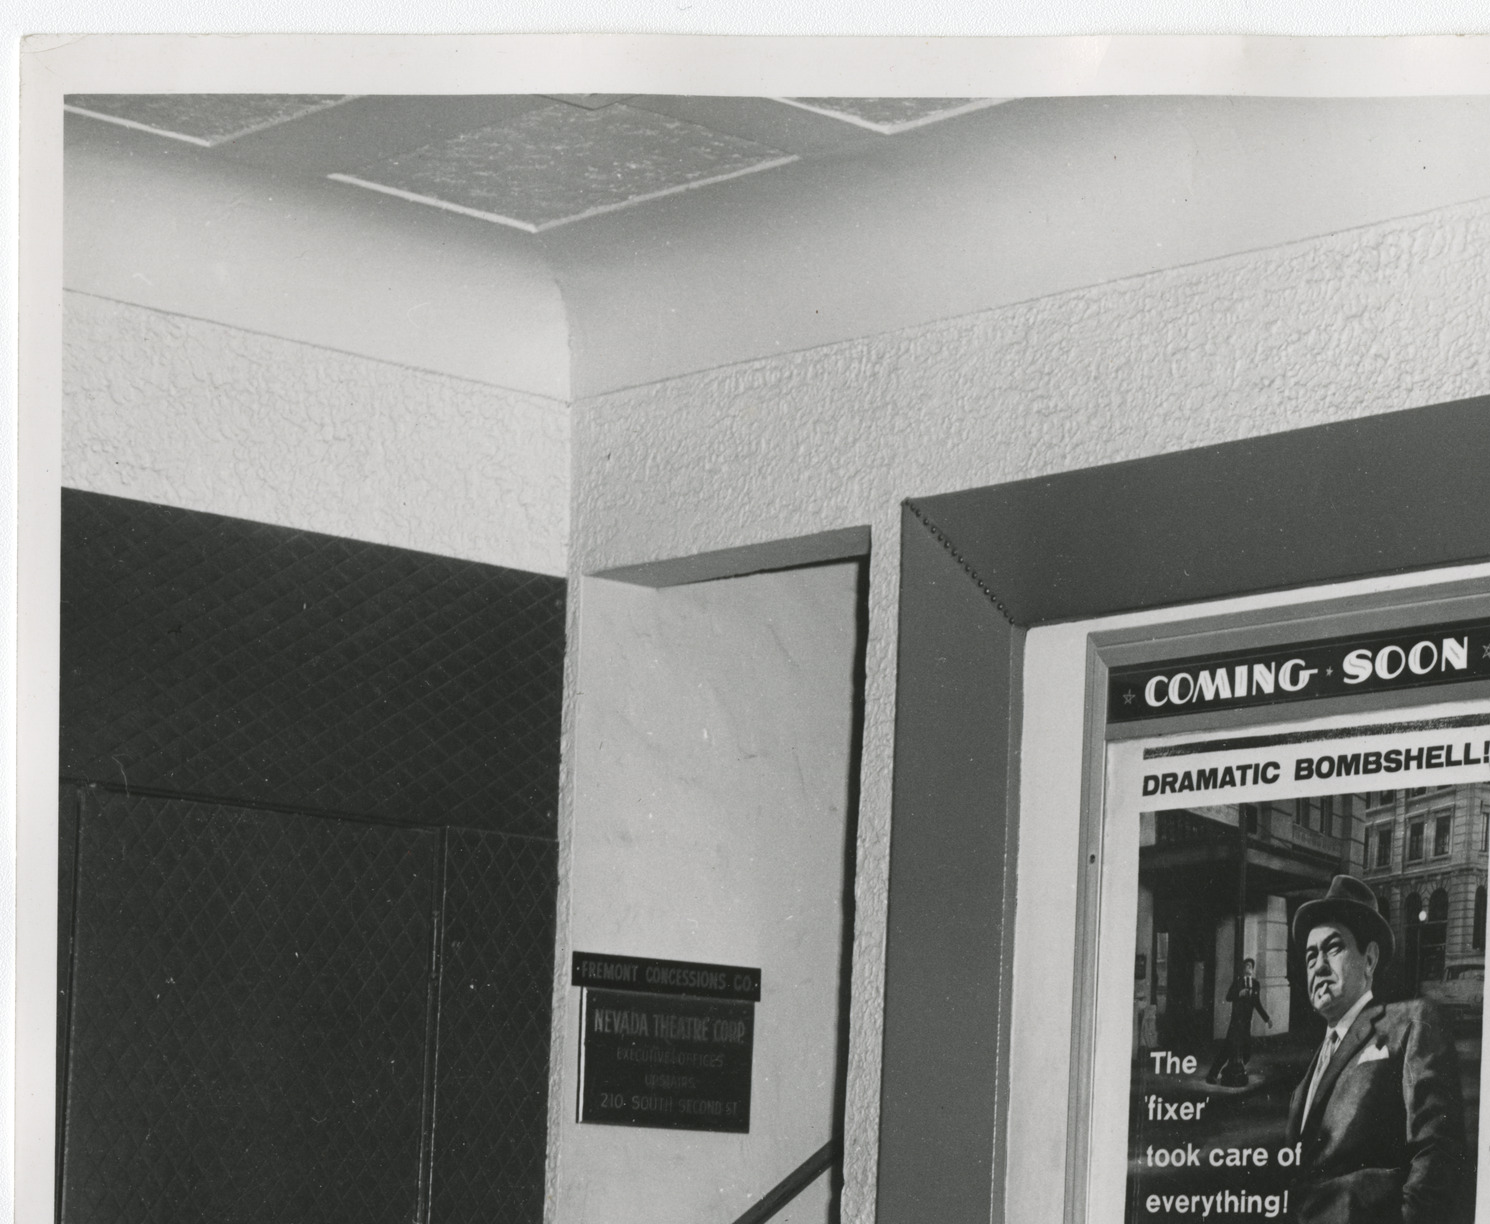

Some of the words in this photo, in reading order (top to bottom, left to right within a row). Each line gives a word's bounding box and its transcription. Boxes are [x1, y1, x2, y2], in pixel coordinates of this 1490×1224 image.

[1144, 658, 1318, 707] COMING
[1342, 636, 1469, 685] SOON
[1142, 760, 1281, 797] DRAMATIC
[1294, 740, 1490, 782] BOMBSHELL!
[581, 960, 639, 983] FREMONT
[645, 966, 727, 991] CONCESSIONS
[594, 1008, 649, 1037] NEVADA
[652, 1013, 709, 1042] THEATRE
[1150, 1051, 1198, 1075] The
[600, 1093, 624, 1109] 210
[632, 1095, 673, 1112] SOUTH
[678, 1099, 722, 1116] SECOND
[1145, 1095, 1210, 1121] 'fixer'
[1146, 1143, 1200, 1167] took
[1208, 1146, 1268, 1167] care
[1277, 1142, 1303, 1166] of
[1145, 1190, 1289, 1218] everything!
